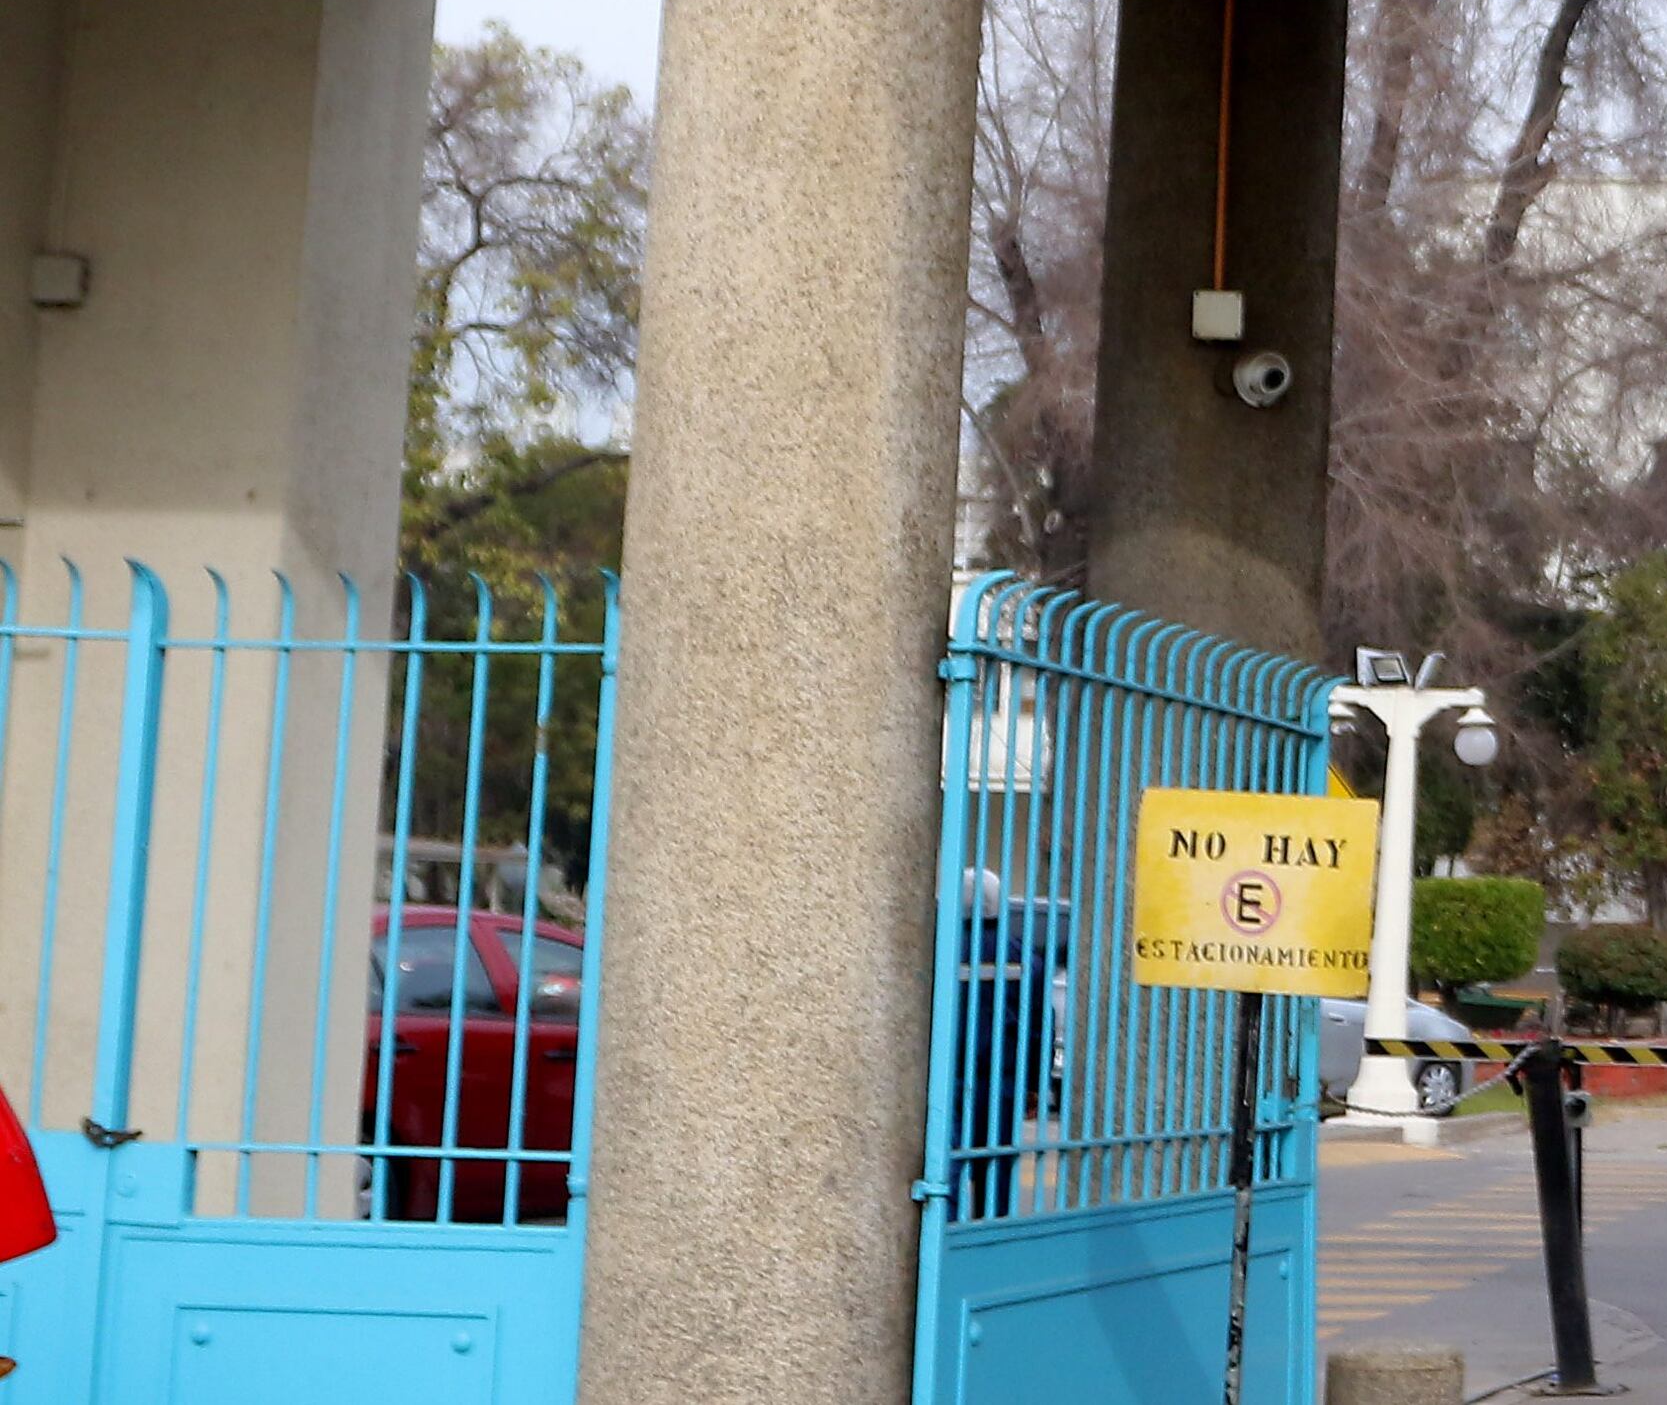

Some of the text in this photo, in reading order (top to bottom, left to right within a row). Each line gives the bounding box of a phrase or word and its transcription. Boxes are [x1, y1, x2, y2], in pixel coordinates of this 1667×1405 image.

[1167, 827, 1348, 870] NO HAY
[1236, 882, 1263, 925] E
[1134, 938, 1370, 971] ESTACIONAMIENTO
